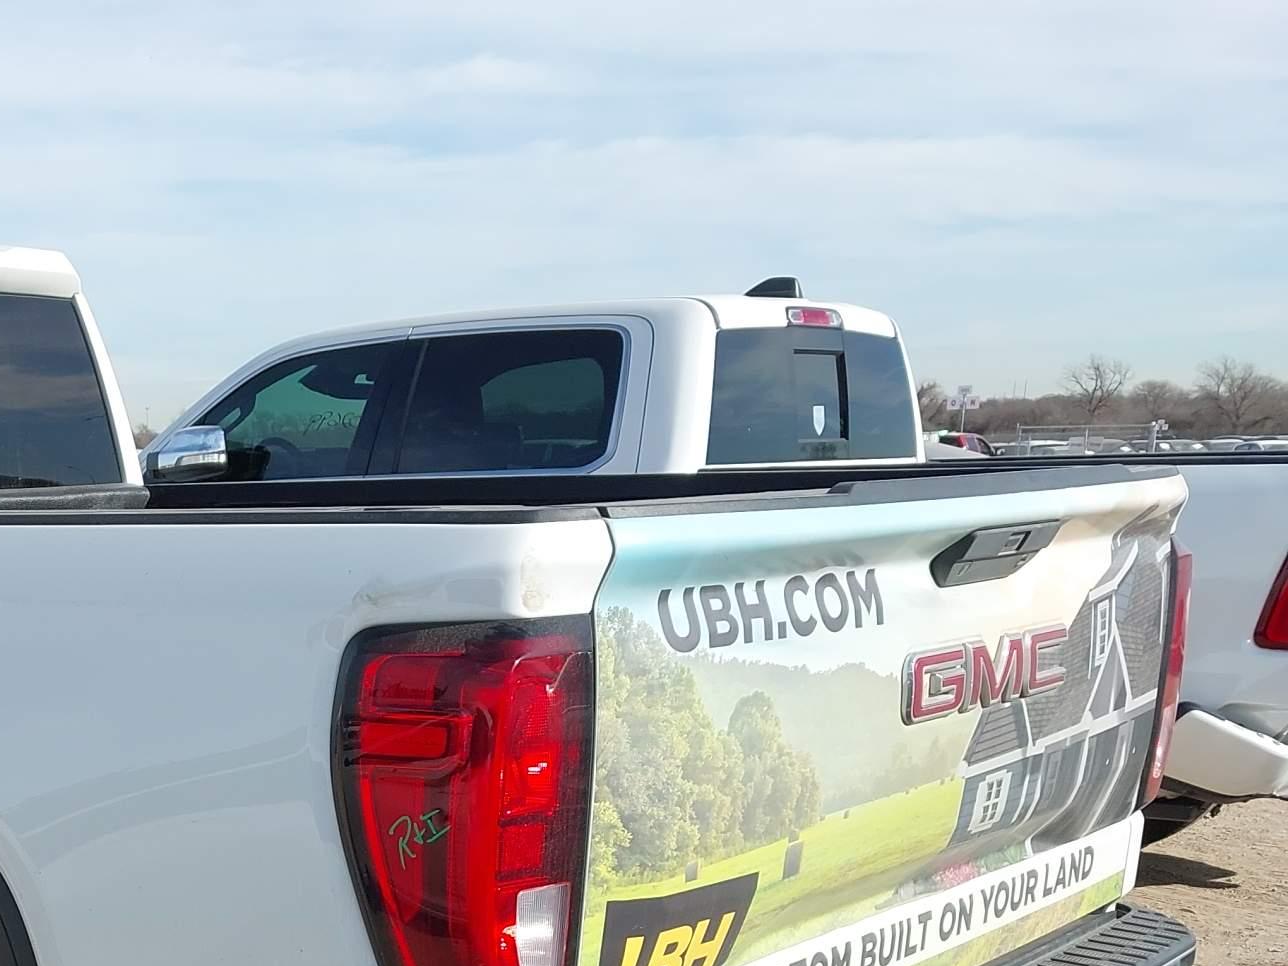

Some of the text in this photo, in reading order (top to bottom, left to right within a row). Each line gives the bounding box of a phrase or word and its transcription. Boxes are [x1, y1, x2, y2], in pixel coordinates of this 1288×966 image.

[658, 568, 885, 654] UBH.COM
[900, 623, 1069, 727] GMC
[939, 893, 974, 942] ON
[981, 877, 1039, 924] YOUR
[1042, 845, 1095, 898] LAND
